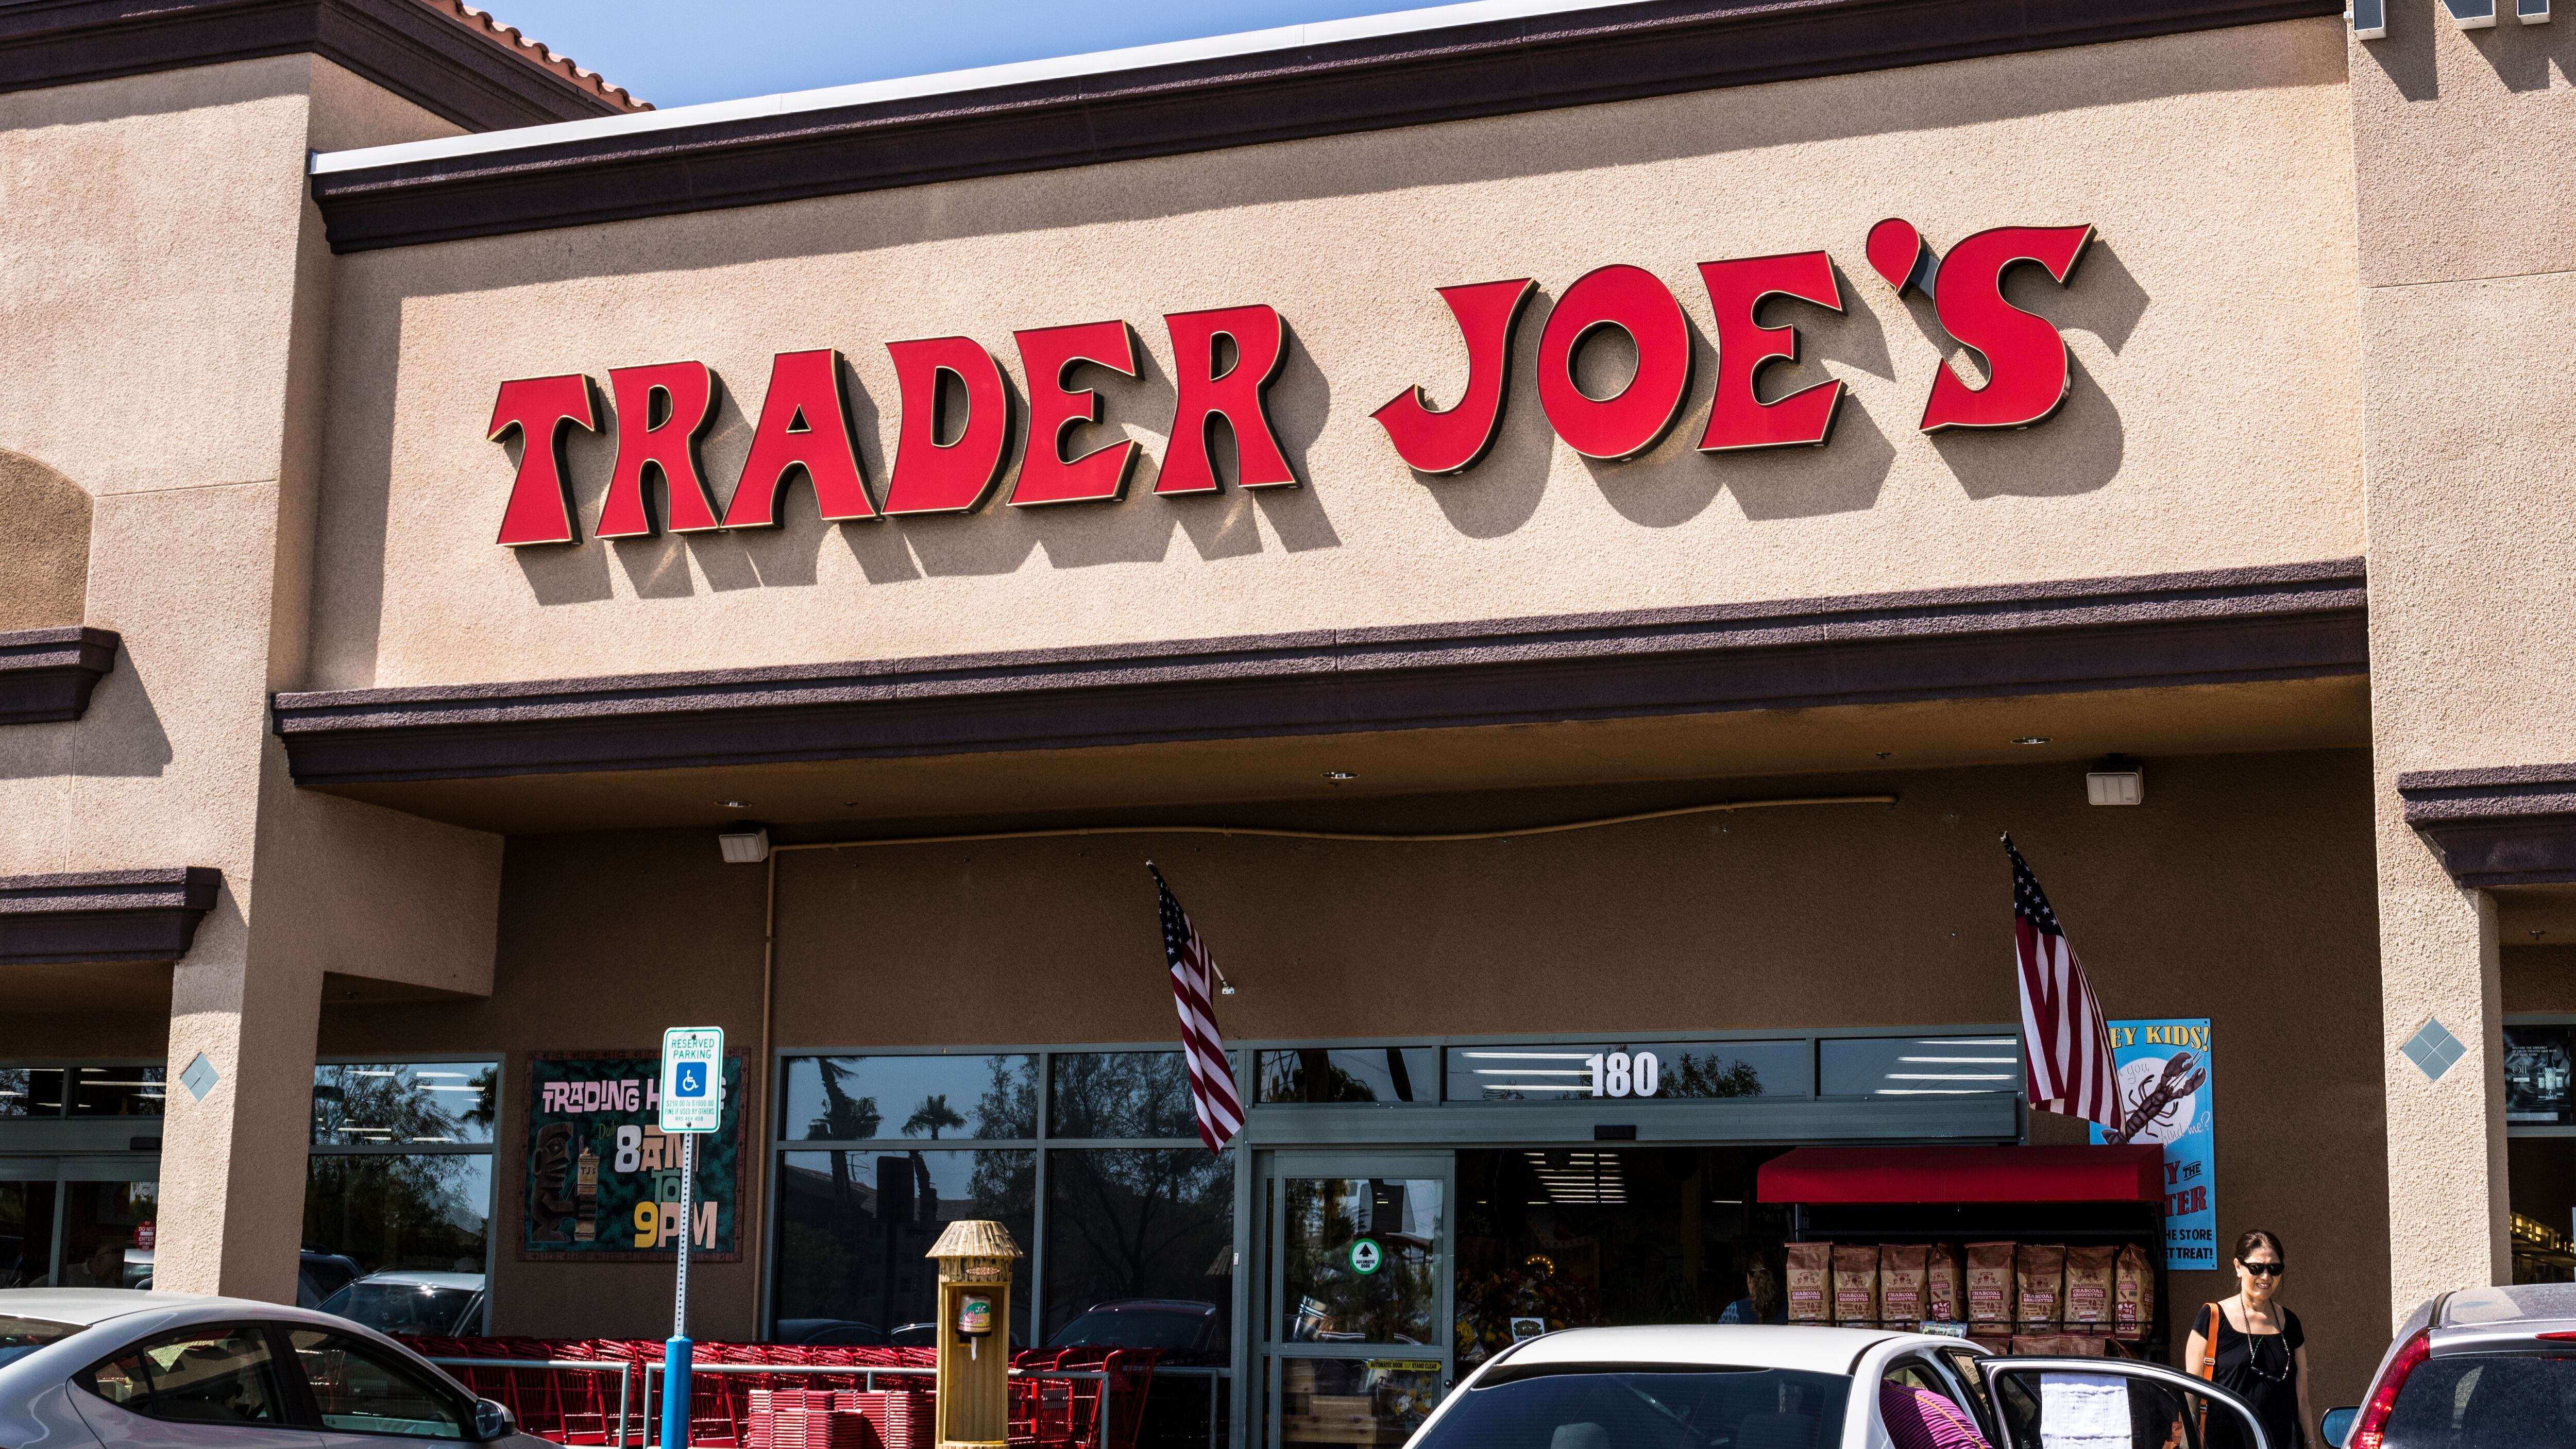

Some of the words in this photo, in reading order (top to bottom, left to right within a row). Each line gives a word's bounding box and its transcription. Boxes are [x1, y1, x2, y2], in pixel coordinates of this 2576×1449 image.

[486, 304, 1301, 545] TRADER
[1368, 218, 2098, 476] JOE'S
[671, 1038, 715, 1048] RESERVED
[2109, 1027, 2138, 1049] EY
[2145, 1026, 2210, 1052] KIDS!
[673, 1050, 711, 1059] PARKING
[1586, 1052, 1658, 1097] 180
[543, 1079, 639, 1113] TRADING
[2188, 1111, 2211, 1135] me?
[2183, 1163, 2201, 1179] THE
[651, 1167, 681, 1205] TO
[2166, 1230, 2177, 1240] HE
[2180, 1229, 2212, 1240] STORE
[2176, 1247, 2213, 1259] TREAT!
